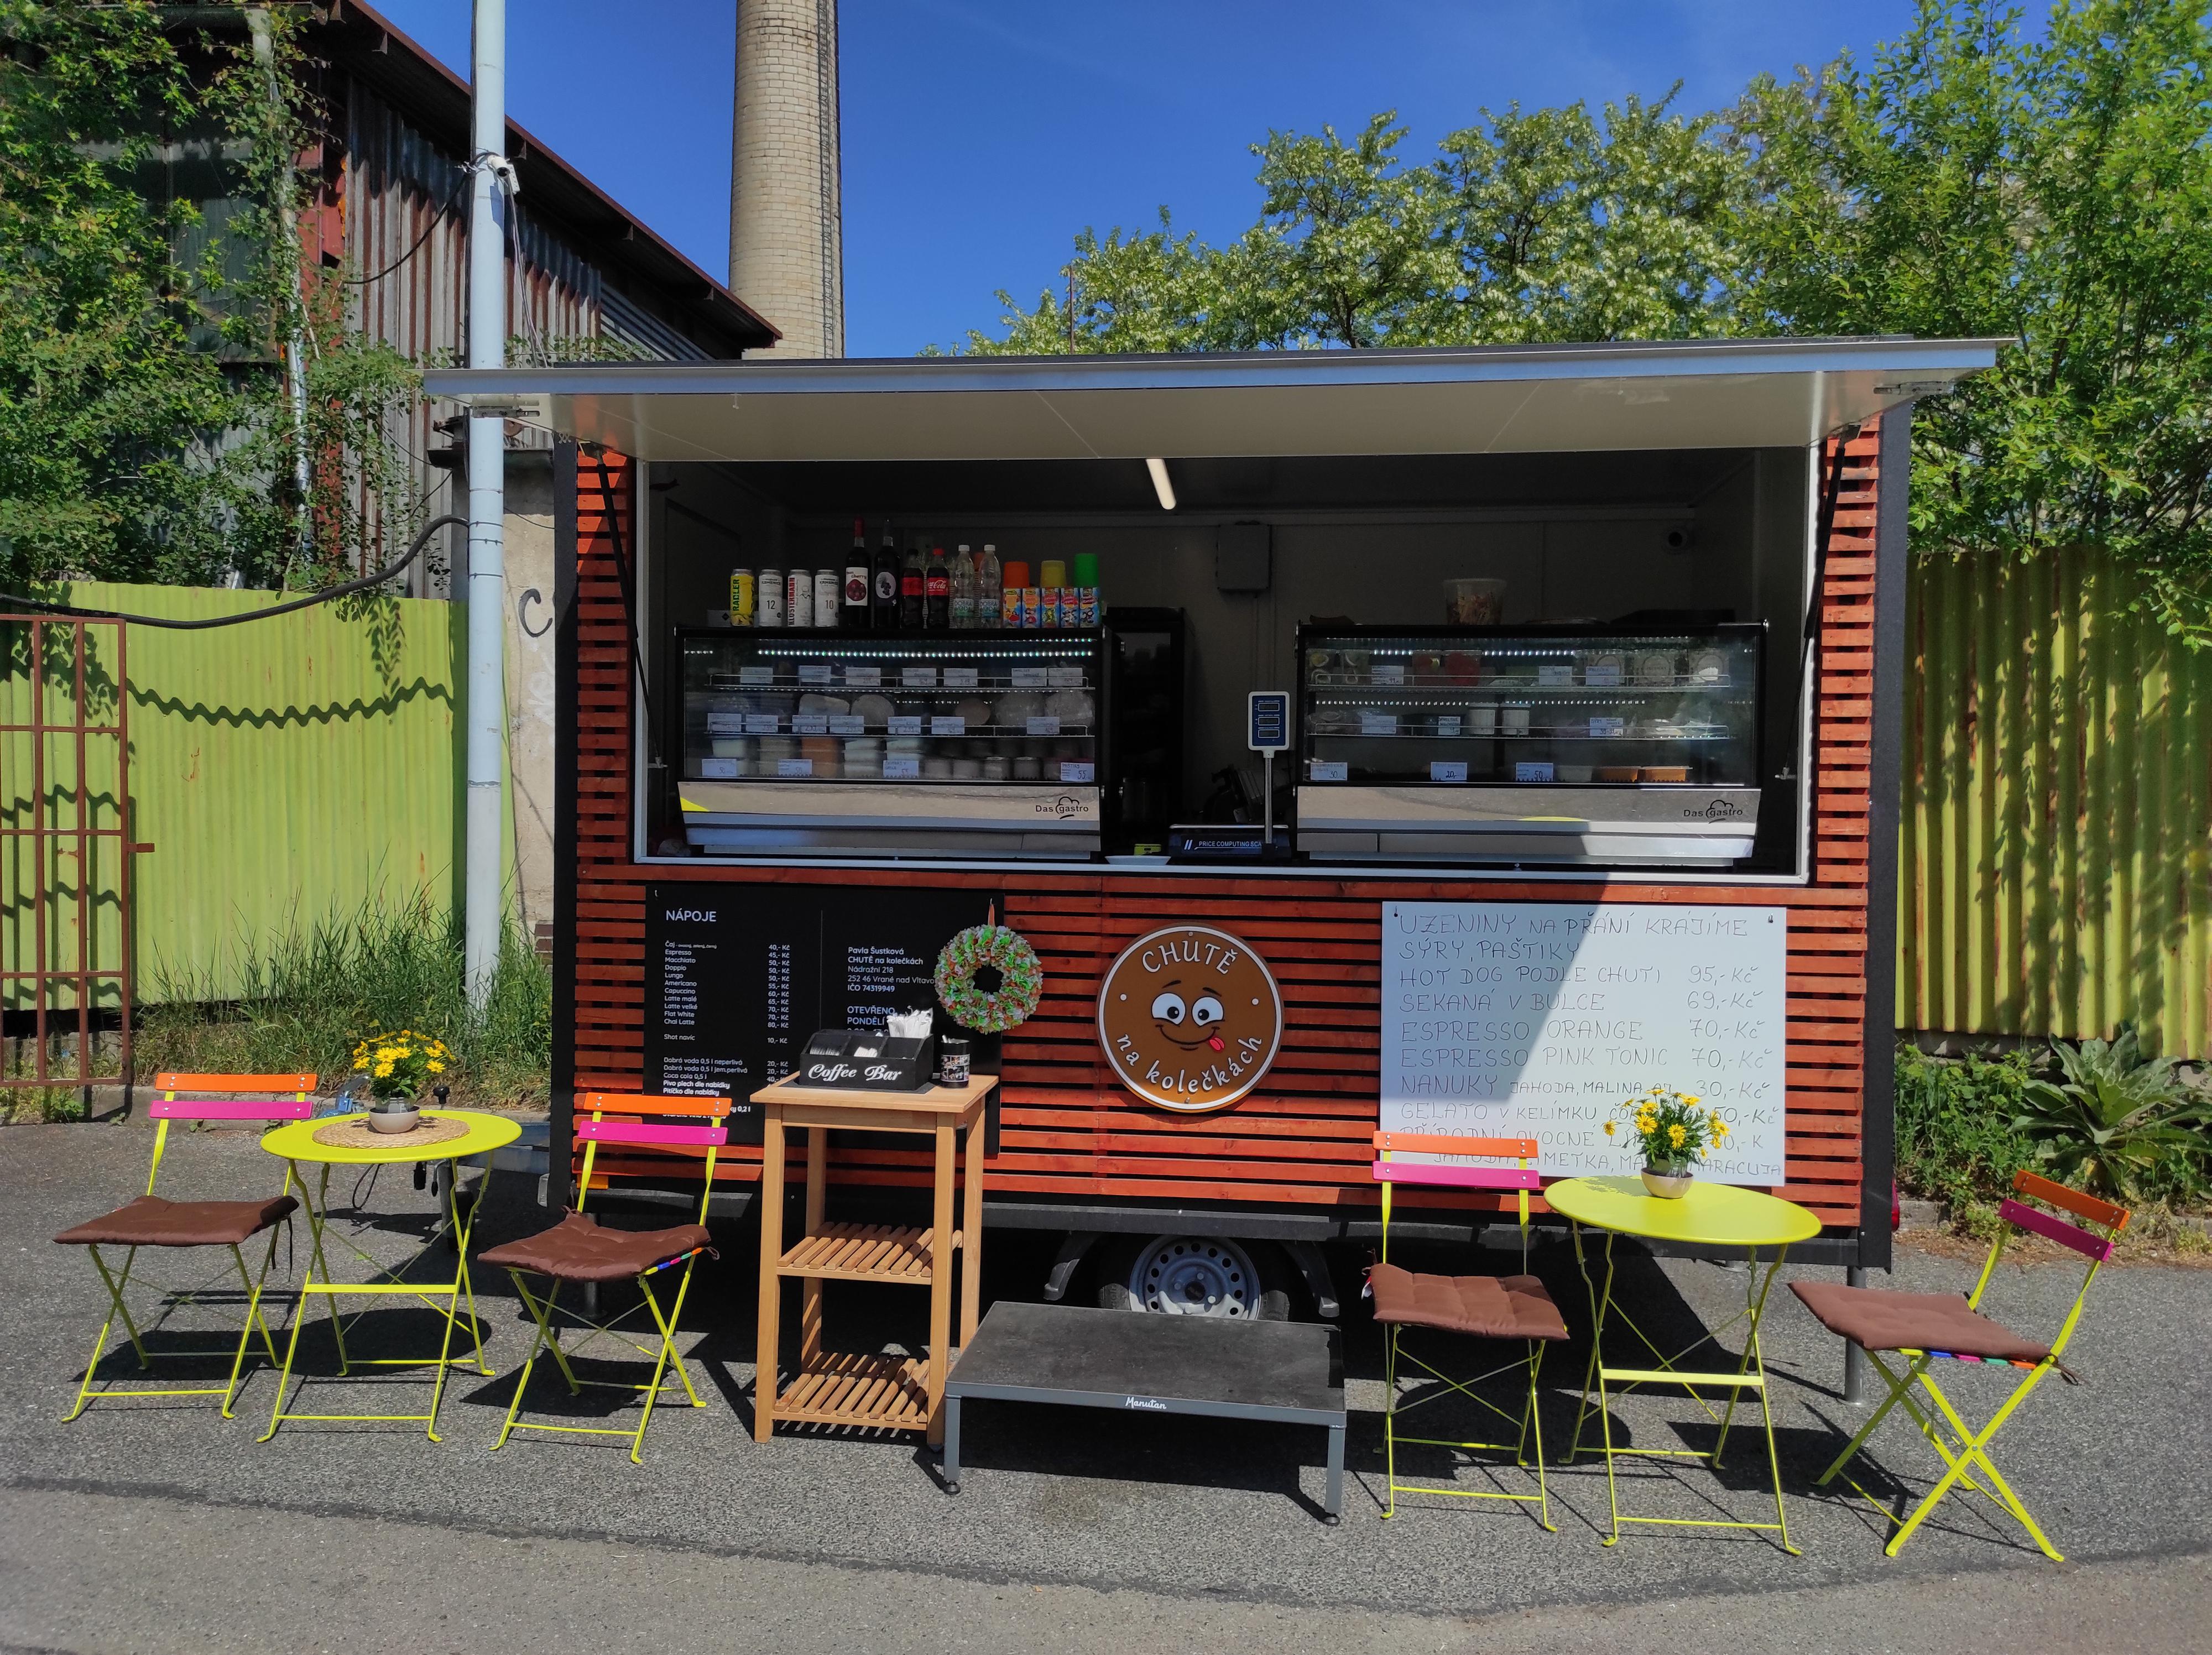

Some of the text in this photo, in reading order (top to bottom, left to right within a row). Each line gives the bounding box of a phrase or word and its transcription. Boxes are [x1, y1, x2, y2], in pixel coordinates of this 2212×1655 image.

[766, 600, 775, 609] 12
[825, 599, 833, 609] 10
[1059, 805, 1089, 813] gastro
[1710, 809, 1743, 818] gastro
[666, 908, 717, 922] NÁPOJE
[1530, 920, 1556, 933] NA
[1564, 912, 1635, 936] PŘÁNÍ
[1645, 911, 1747, 936] KRÁJÍME
[665, 940, 675, 948] Čaj
[870, 946, 904, 955] Šustková
[1476, 938, 1579, 962] PAŠTIKY
[1142, 940, 1238, 975] CHUTĚ
[1400, 965, 1759, 987] HOT DOG PODLE CHUTI 95,- Kč
[1400, 988, 1764, 1012] SEKANÁ V BULCE 69,- Kč
[847, 1005, 895, 1015] OTEVŘENO
[847, 1017, 885, 1025] PONDĚLÍ
[1401, 1019, 1766, 1042] ESPRESSO ORANGE 70,- Kč
[1117, 1033, 1262, 1093] na kolečkách
[1401, 1047, 1773, 1071] ESPRESSO PINK TONIC 70,- Kč
[808, 1064, 902, 1082] Coffee Bar
[1401, 1074, 1498, 1095] NANUKY
[1510, 1082, 1579, 1097] JAHODA,
[1583, 1081, 1642, 1094] MALINA
[1693, 1079, 1735, 1100] 30,-
[1739, 1080, 1771, 1099] Kč
[1401, 1102, 1488, 1120] GELATO
[1516, 1100, 1597, 1120] KELÍMKU
[1609, 1103, 1636, 1120] ČOK
[1527, 1152, 1613, 1172] IMETKA,
[1620, 1155, 1647, 1170] MA
[1125, 1396, 1167, 1409] Manutan
